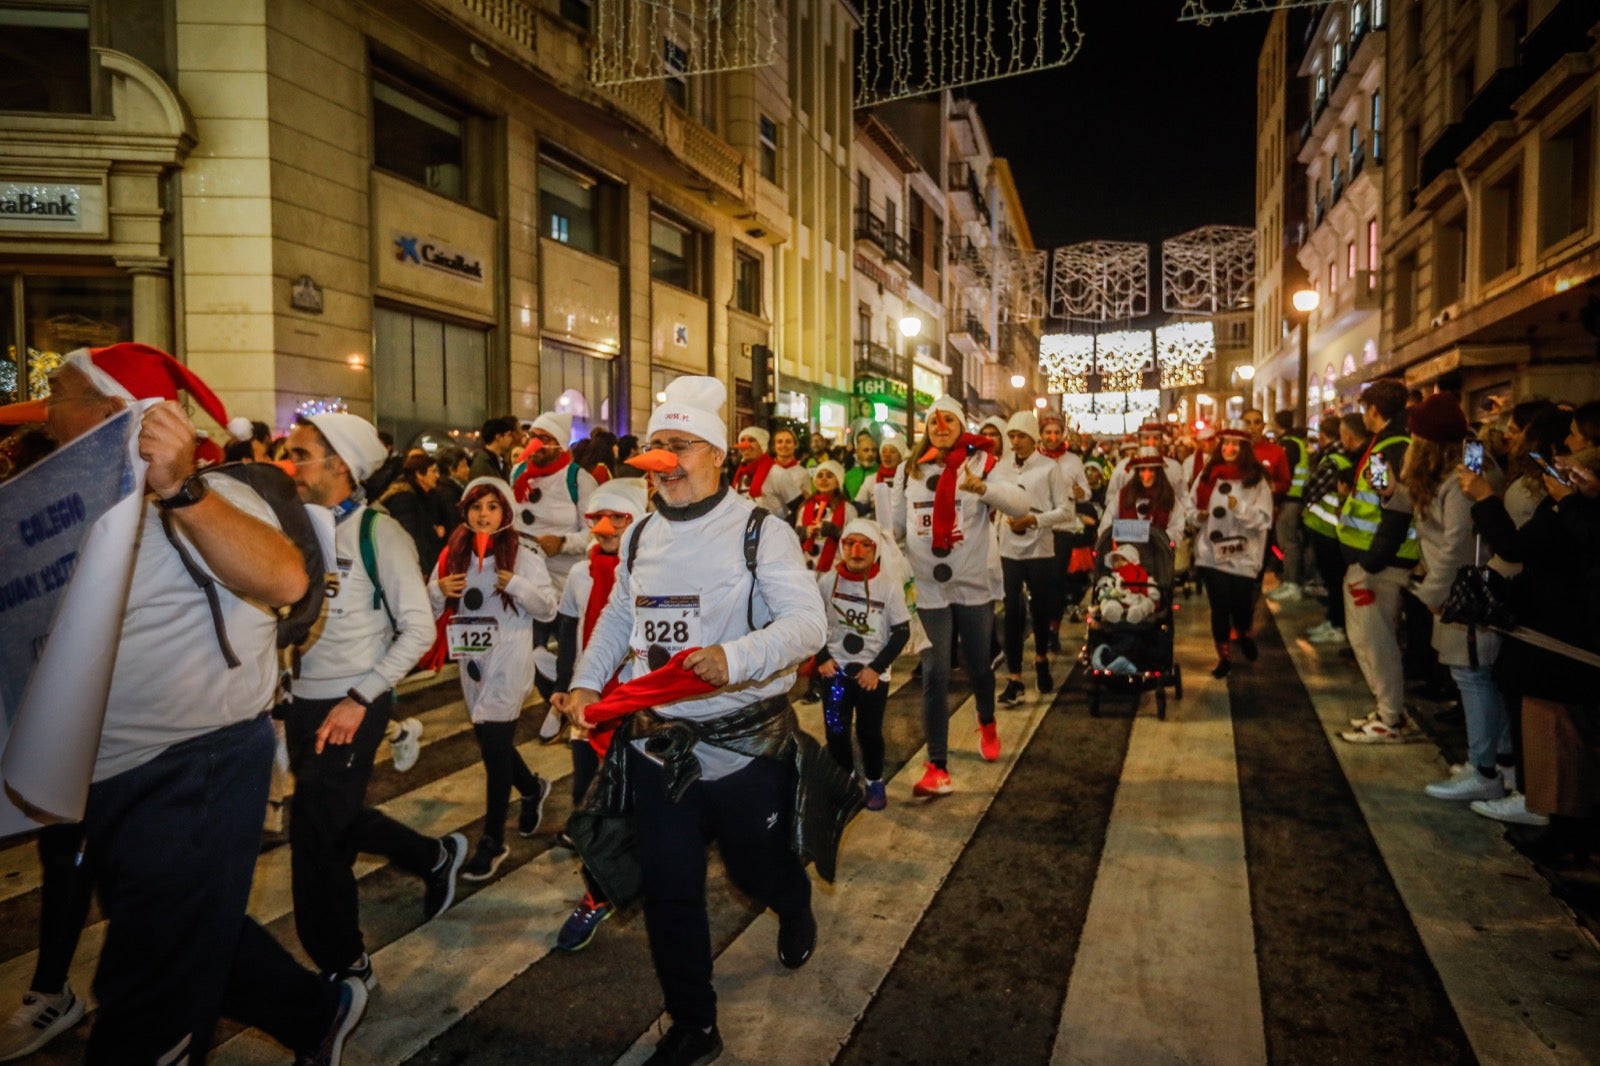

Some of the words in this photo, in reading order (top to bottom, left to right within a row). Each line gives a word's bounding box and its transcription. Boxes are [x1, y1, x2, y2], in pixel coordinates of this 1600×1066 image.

[857, 380, 886, 395] 16H
[19, 491, 86, 547] COLEGIO
[461, 631, 493, 647] 122
[645, 620, 689, 643] 828
